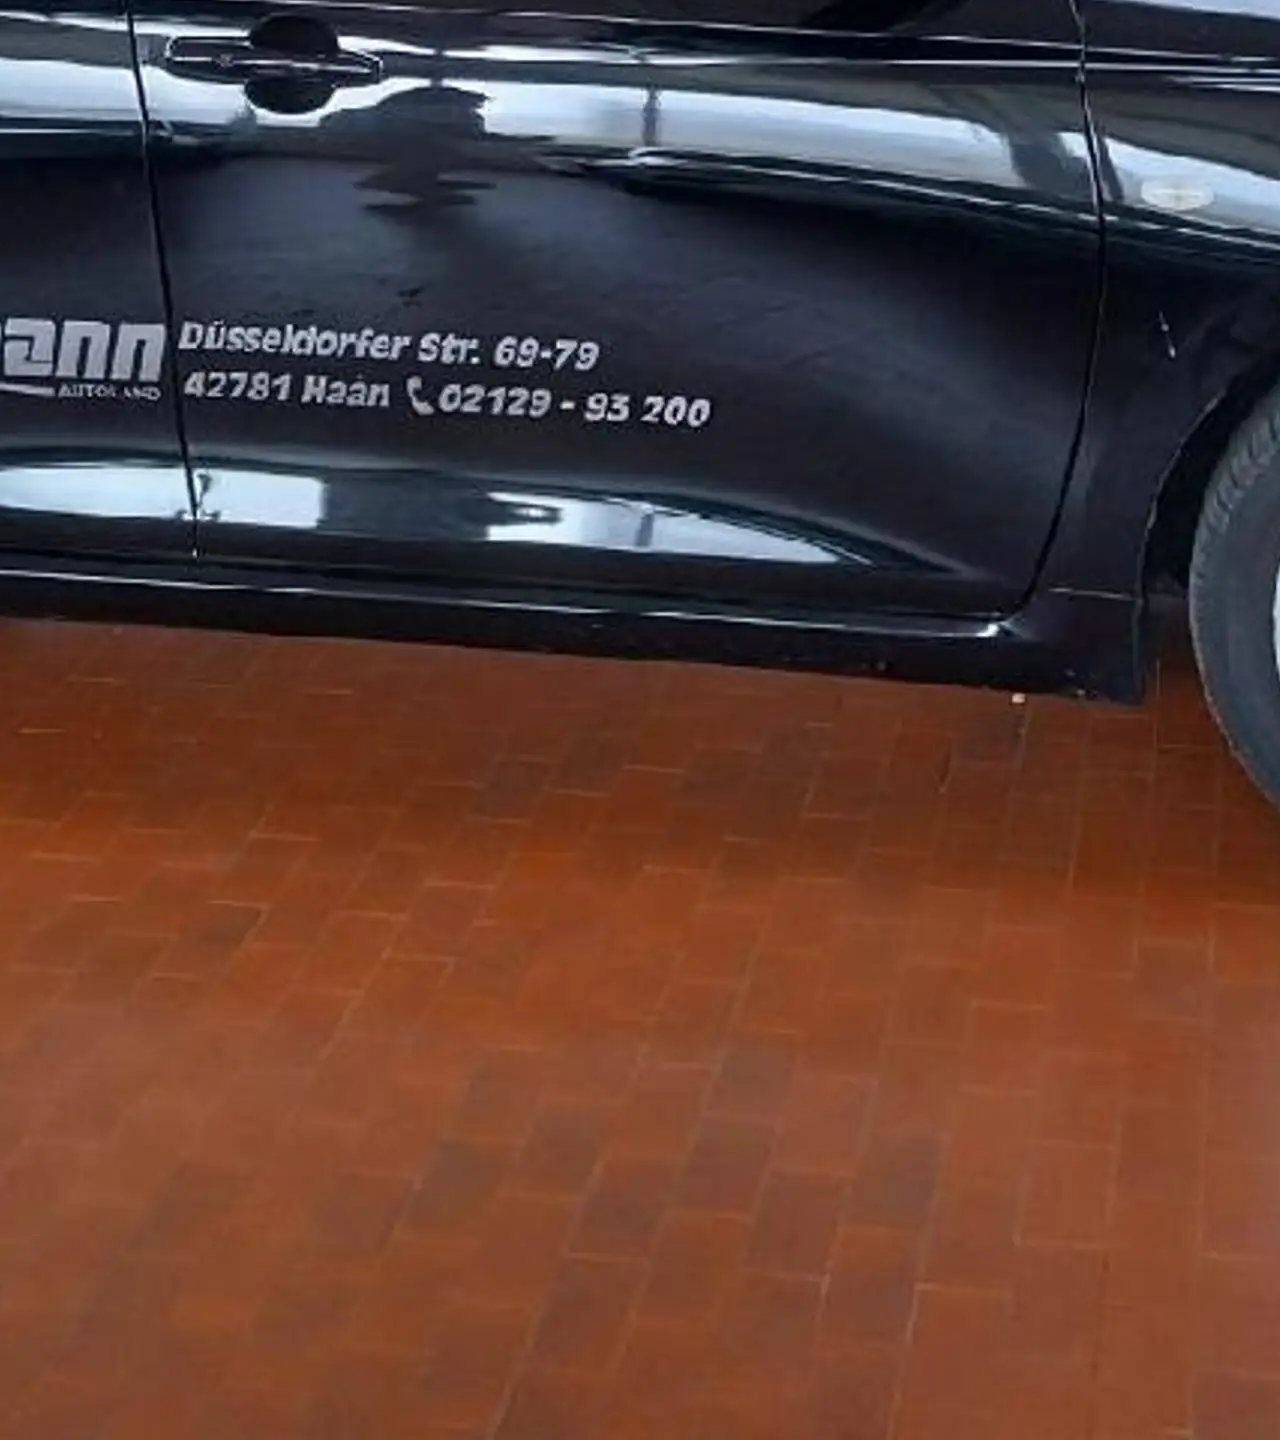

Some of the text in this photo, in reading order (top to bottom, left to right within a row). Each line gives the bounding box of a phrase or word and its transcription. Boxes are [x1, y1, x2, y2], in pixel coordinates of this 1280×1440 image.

[178, 320, 601, 371] Düsseldorfer Str. 69-79
[183, 370, 293, 402] 42781
[300, 374, 390, 408] Haan
[438, 382, 552, 418] 02129
[584, 392, 630, 423] 93
[640, 395, 711, 428] 200
